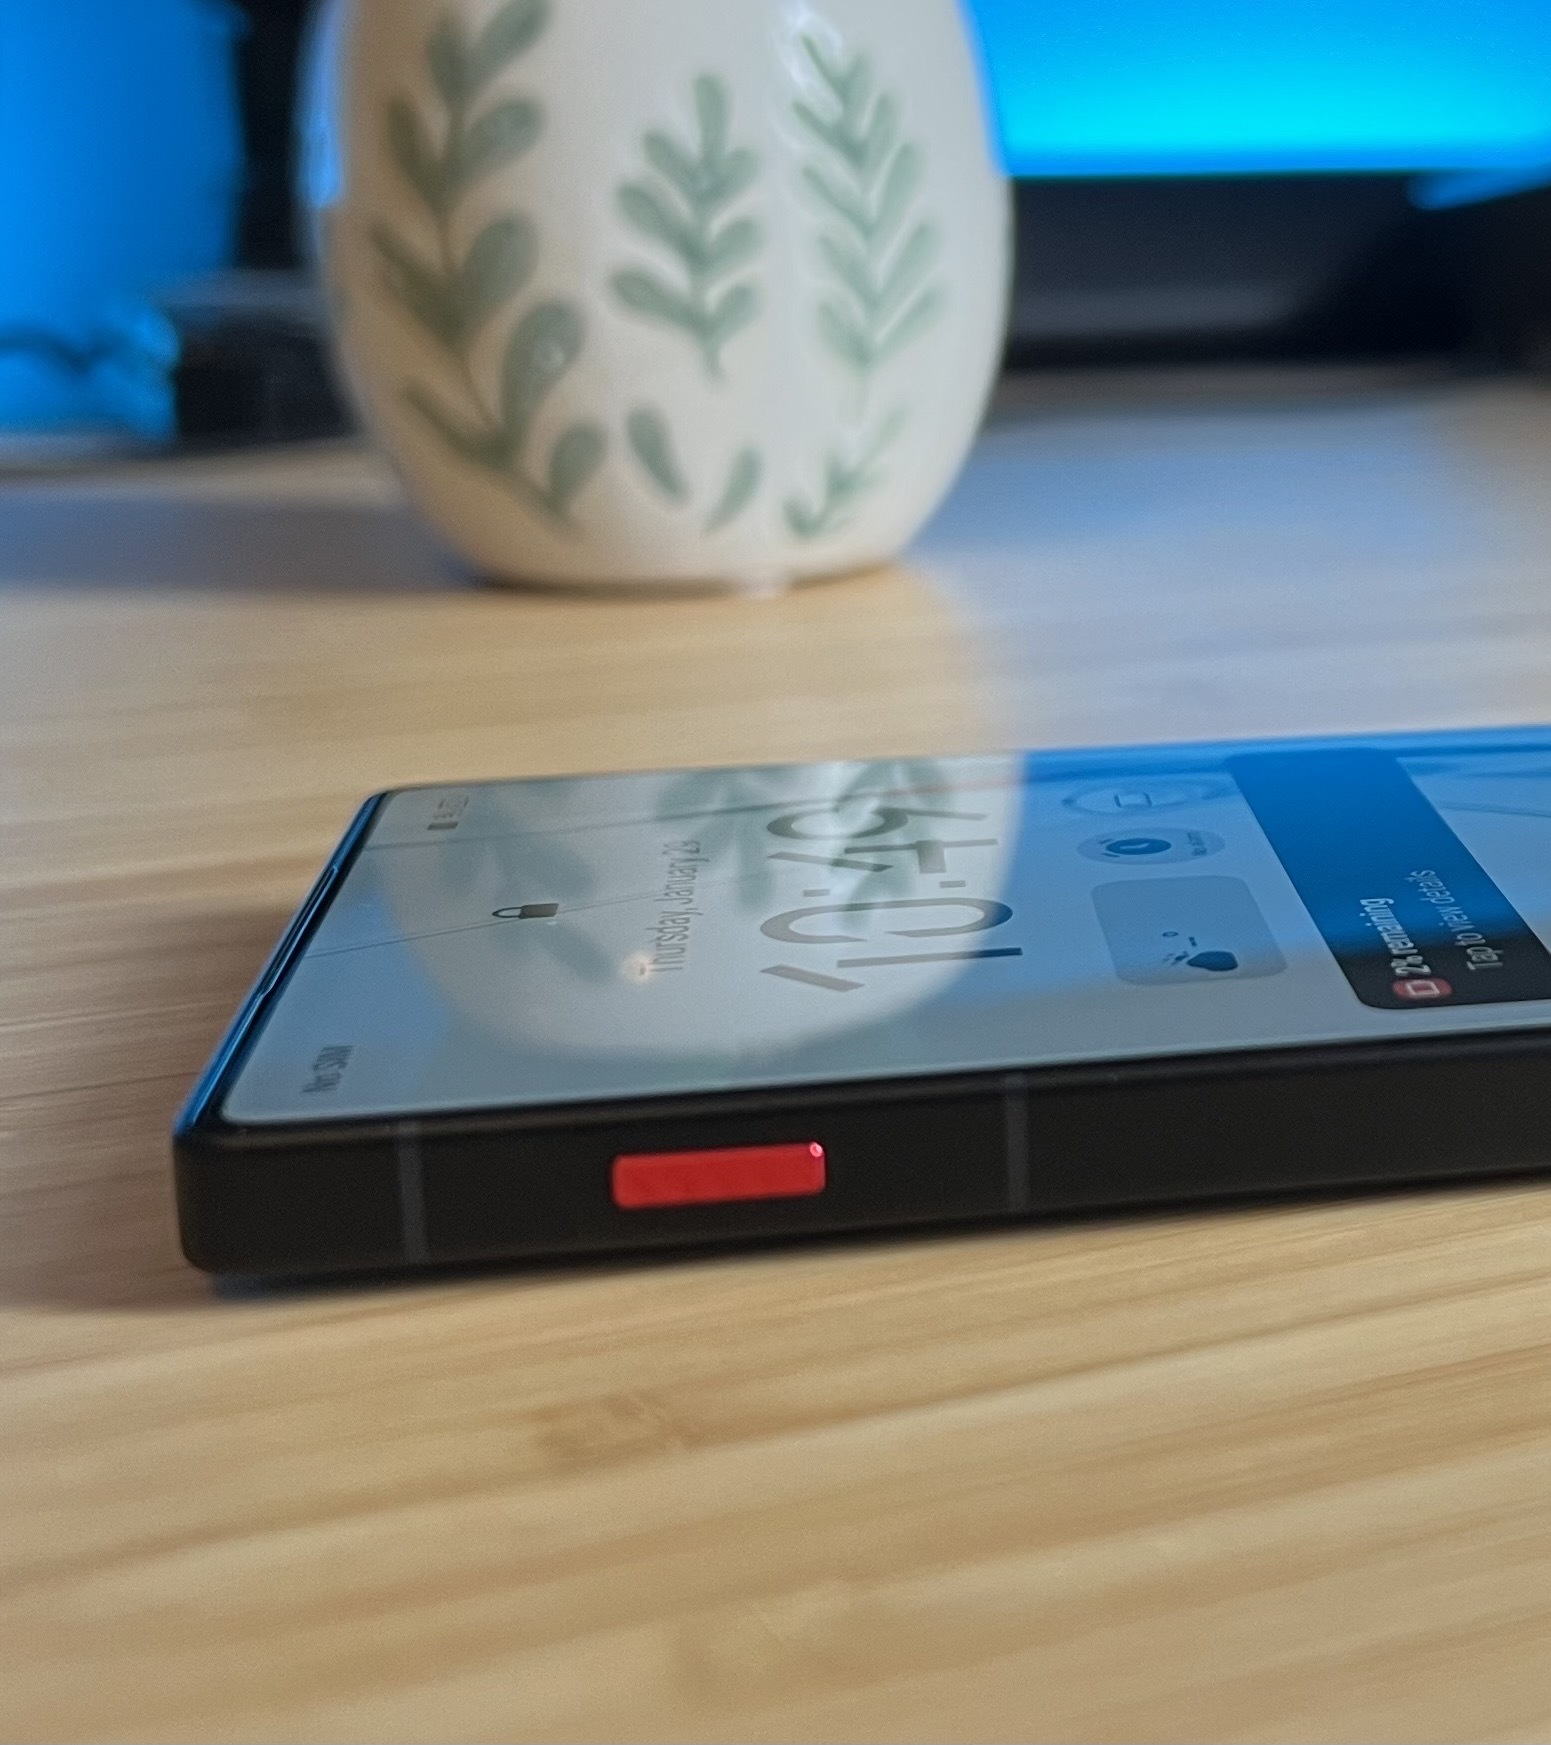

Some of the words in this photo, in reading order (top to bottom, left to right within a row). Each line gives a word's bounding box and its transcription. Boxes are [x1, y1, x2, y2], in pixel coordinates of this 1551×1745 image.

[662, 839, 701, 855] 29
[653, 857, 710, 905] January
[1405, 869, 1456, 904] details
[759, 807, 1023, 992] 10:49
[1359, 898, 1419, 955] remaining
[1435, 906, 1475, 932] view
[640, 908, 704, 976] Thursday,
[1455, 932, 1486, 947] to
[1390, 955, 1431, 977] 2%
[1466, 947, 1503, 971] Tap
[312, 1045, 353, 1071] SIM
[301, 1072, 343, 1093] No
